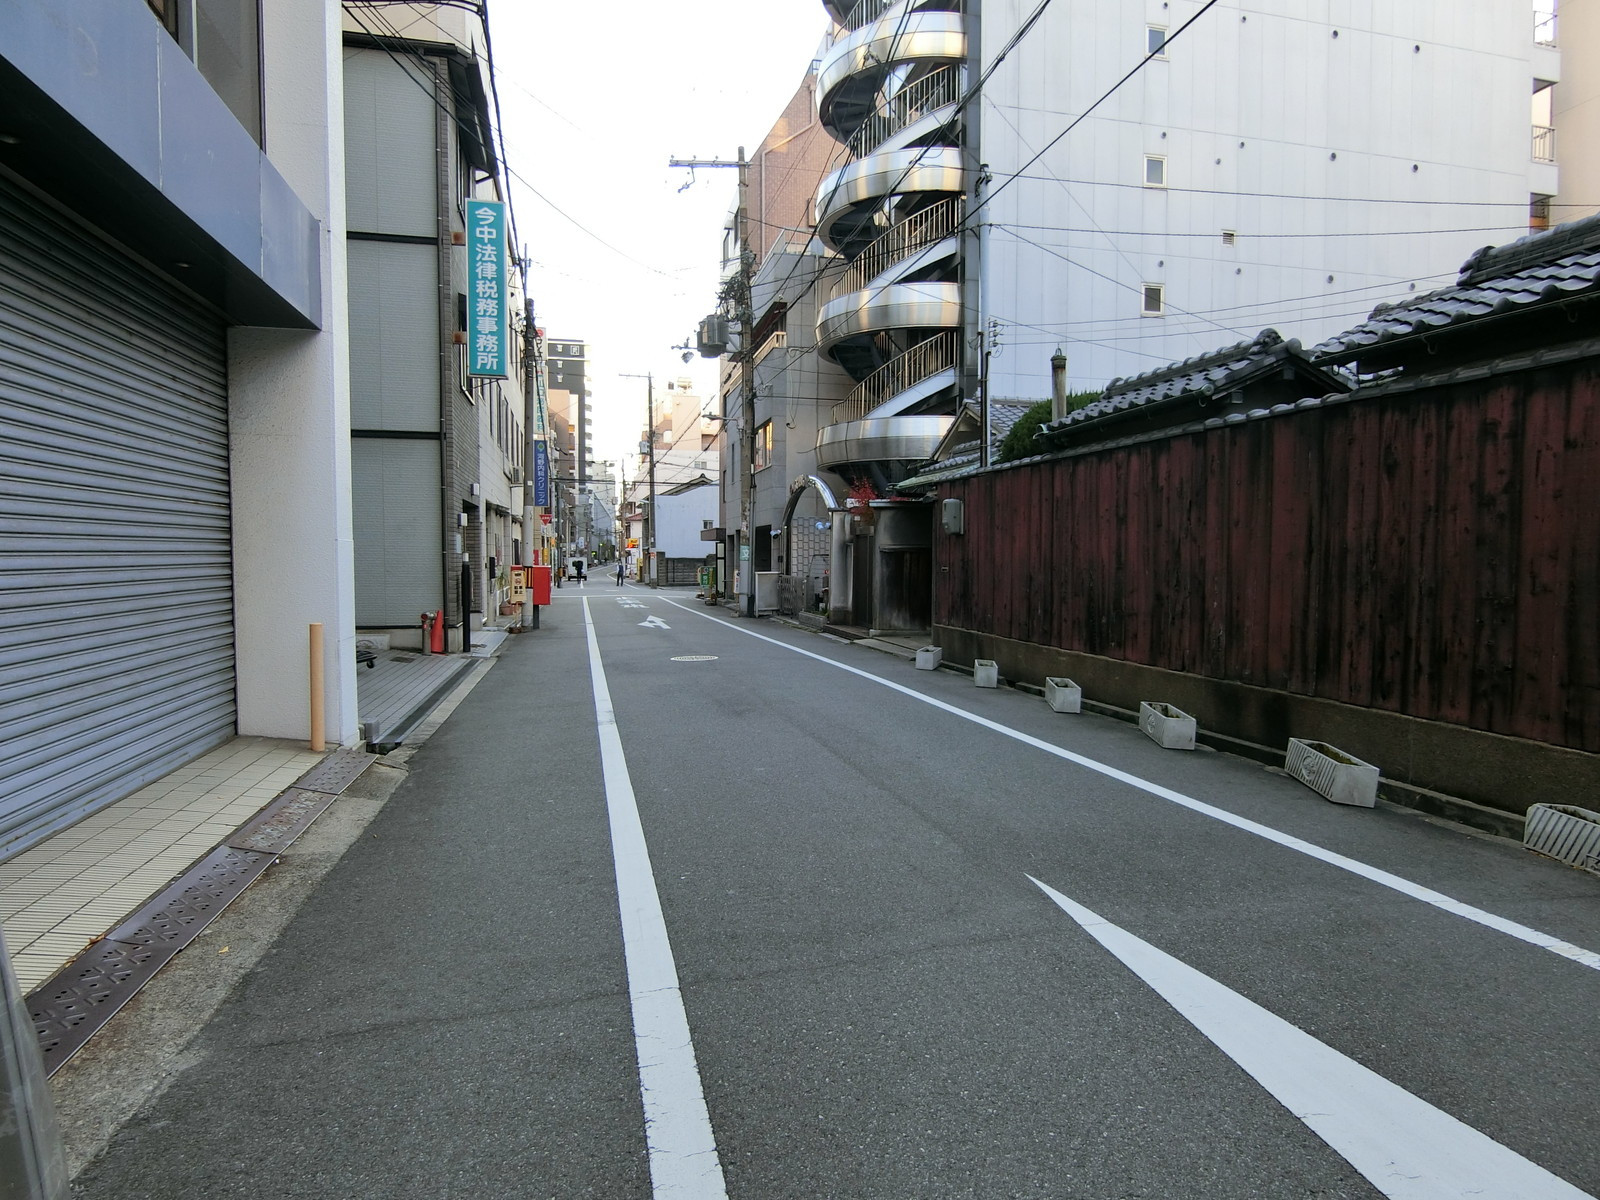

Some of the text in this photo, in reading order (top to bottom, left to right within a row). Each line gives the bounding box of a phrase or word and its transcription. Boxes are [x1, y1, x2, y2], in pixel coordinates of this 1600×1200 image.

[475, 207, 498, 370] 今中法律税務事務所
